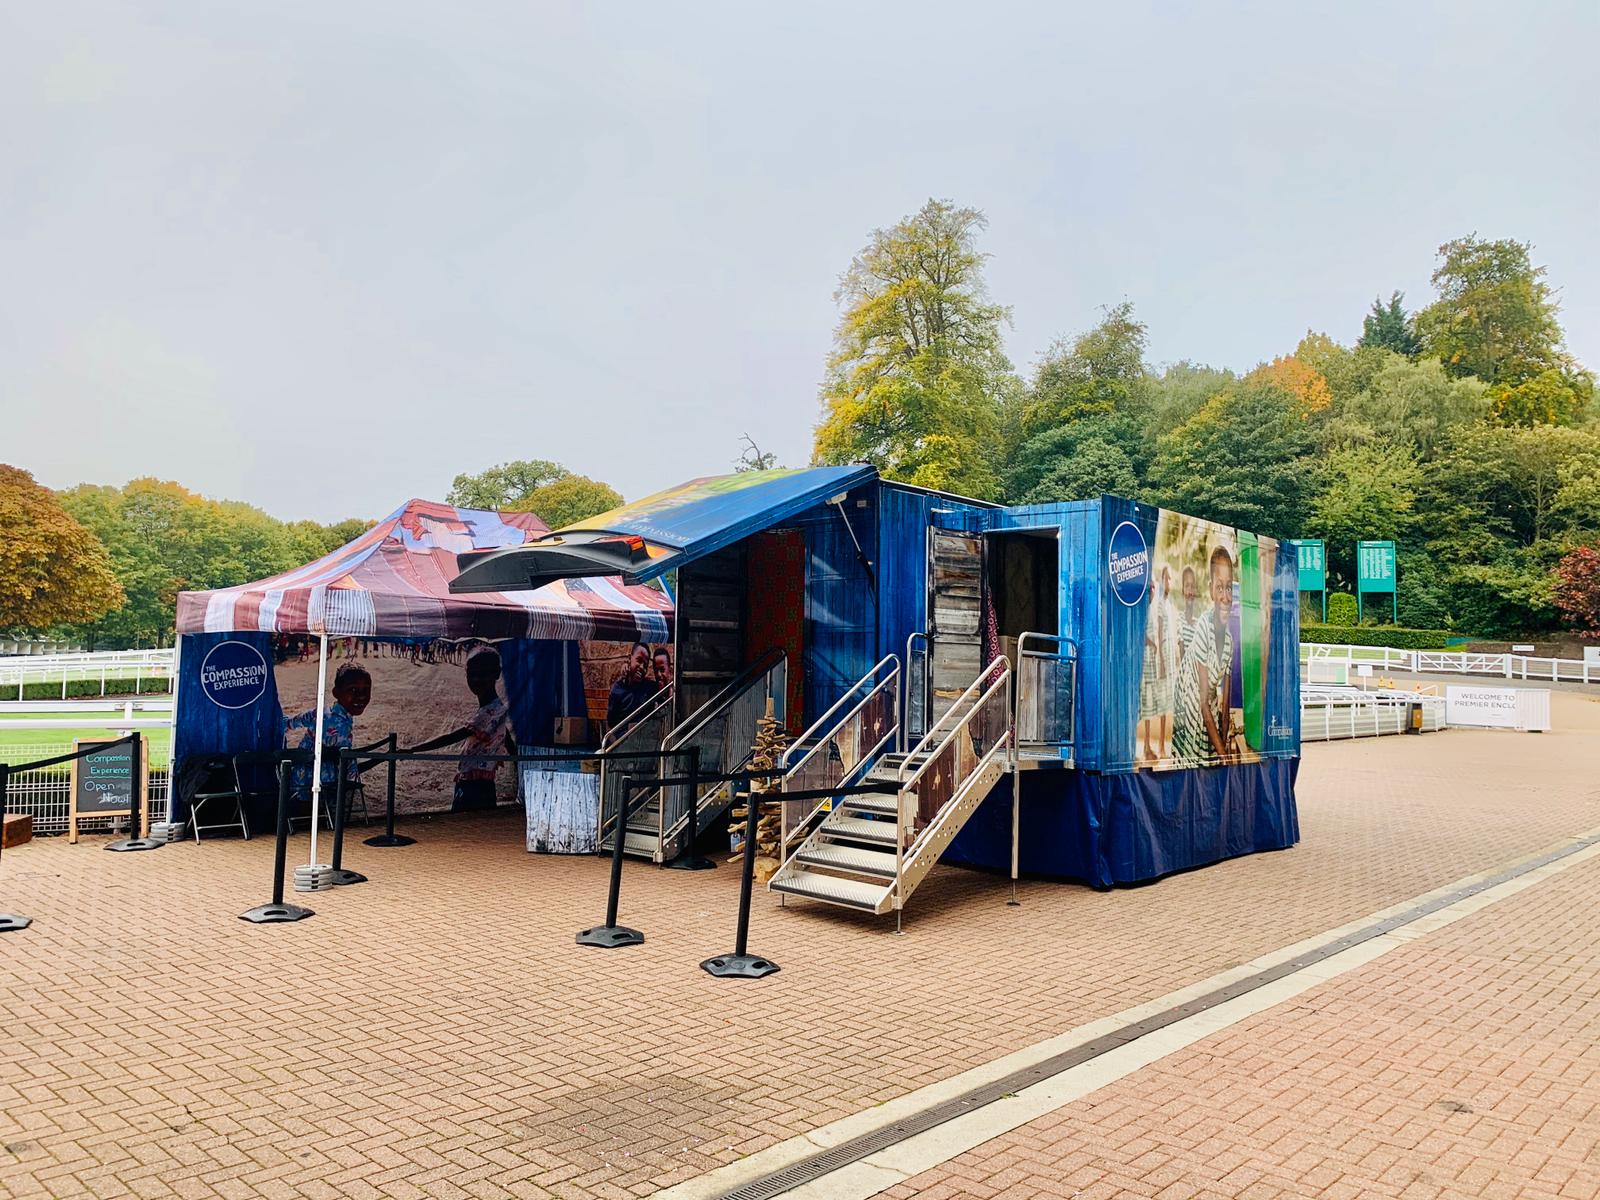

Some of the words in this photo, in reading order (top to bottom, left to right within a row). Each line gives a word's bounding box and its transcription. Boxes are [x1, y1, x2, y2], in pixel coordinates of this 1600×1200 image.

[1110, 550, 1148, 575] COMPASSION
[1117, 565, 1144, 583] EXPERIENCE
[202, 664, 265, 683] COMPASSION
[206, 665, 216, 673] THE
[213, 676, 259, 690] EXPERIENCE
[1454, 700, 1489, 708] PREMIER
[85, 754, 131, 764] Compassion
[90, 766, 130, 775] Experience
[84, 780, 115, 793] Open
